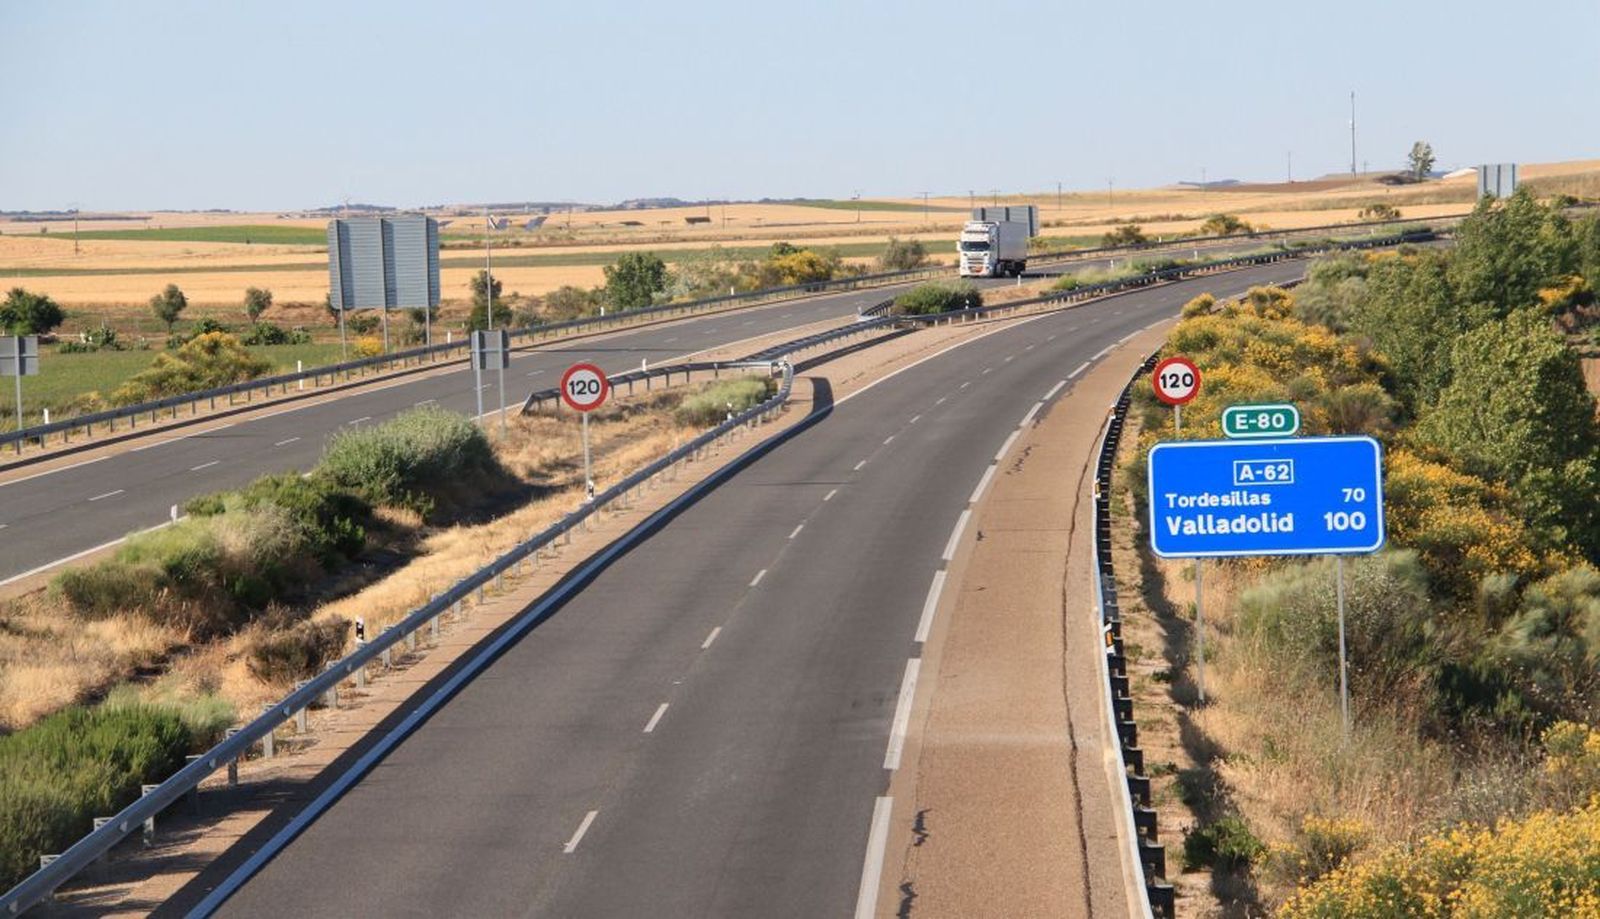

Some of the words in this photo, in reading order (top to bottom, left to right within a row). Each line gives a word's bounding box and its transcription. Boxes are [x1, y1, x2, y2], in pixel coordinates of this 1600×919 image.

[568, 379, 600, 395] 120
[1160, 372, 1194, 389] 120
[1235, 413, 1285, 430] E-80
[1239, 463, 1290, 481] A-62
[1164, 490, 1271, 508] Tordesillas
[1342, 488, 1365, 503] 70
[1166, 512, 1294, 536] Valladolid
[1324, 511, 1366, 531] 100
